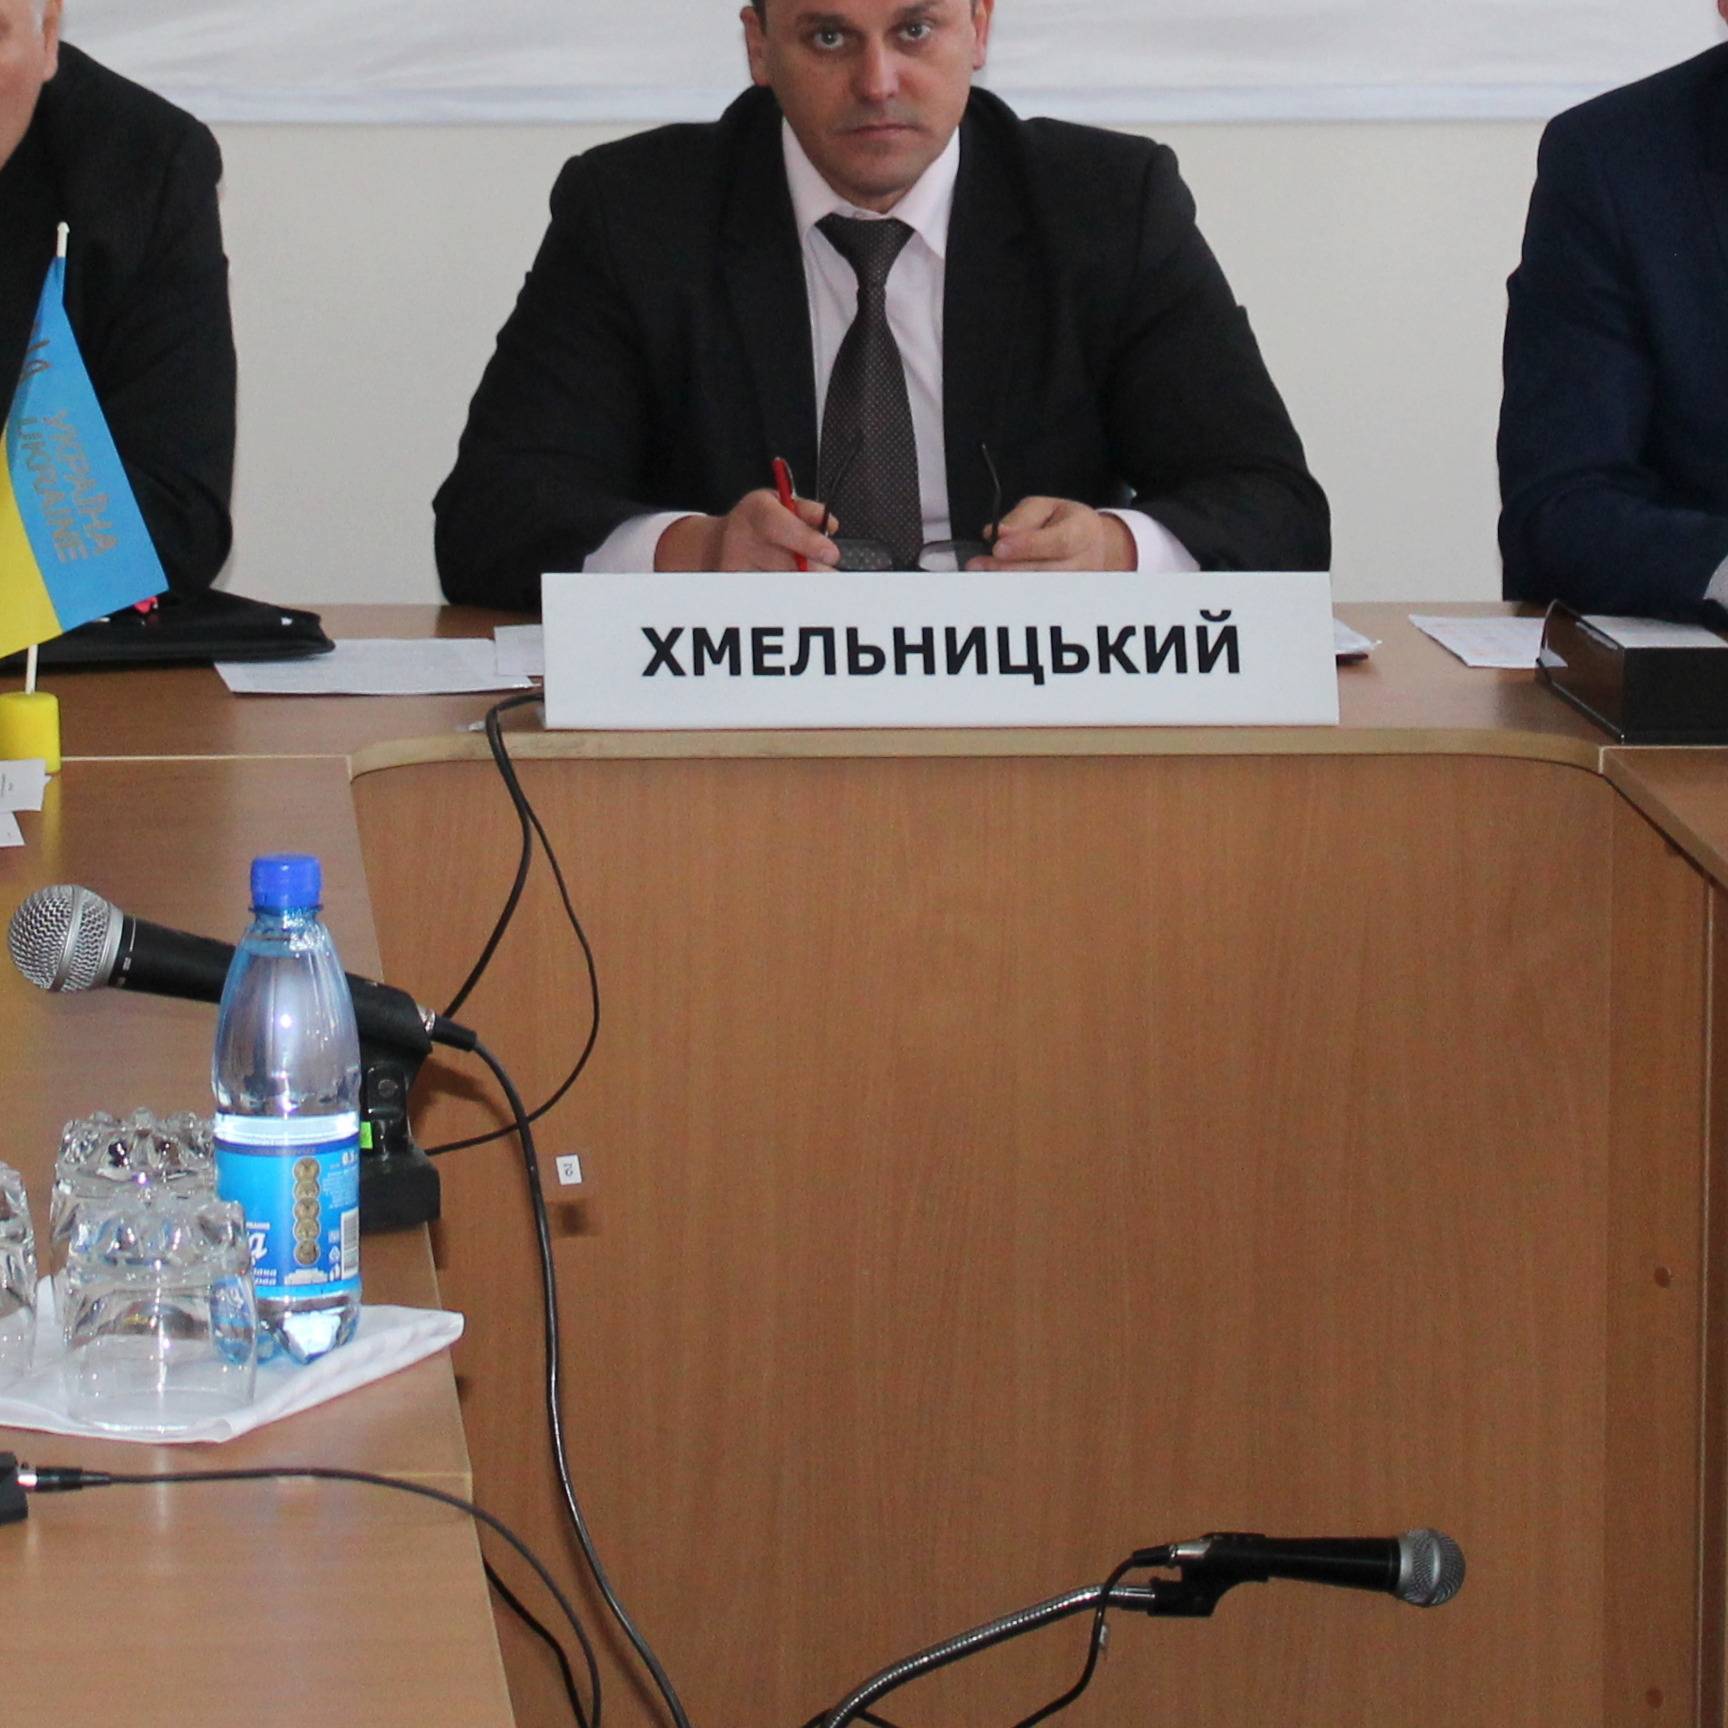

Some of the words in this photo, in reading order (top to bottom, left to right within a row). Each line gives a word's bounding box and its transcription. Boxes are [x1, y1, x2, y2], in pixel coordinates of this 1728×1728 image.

[18, 416, 89, 563] UKRAINE
[43, 409, 119, 556] УКРАЇНА
[641, 609, 1241, 686] ХМЕЛЬНИЦЬКИЙ
